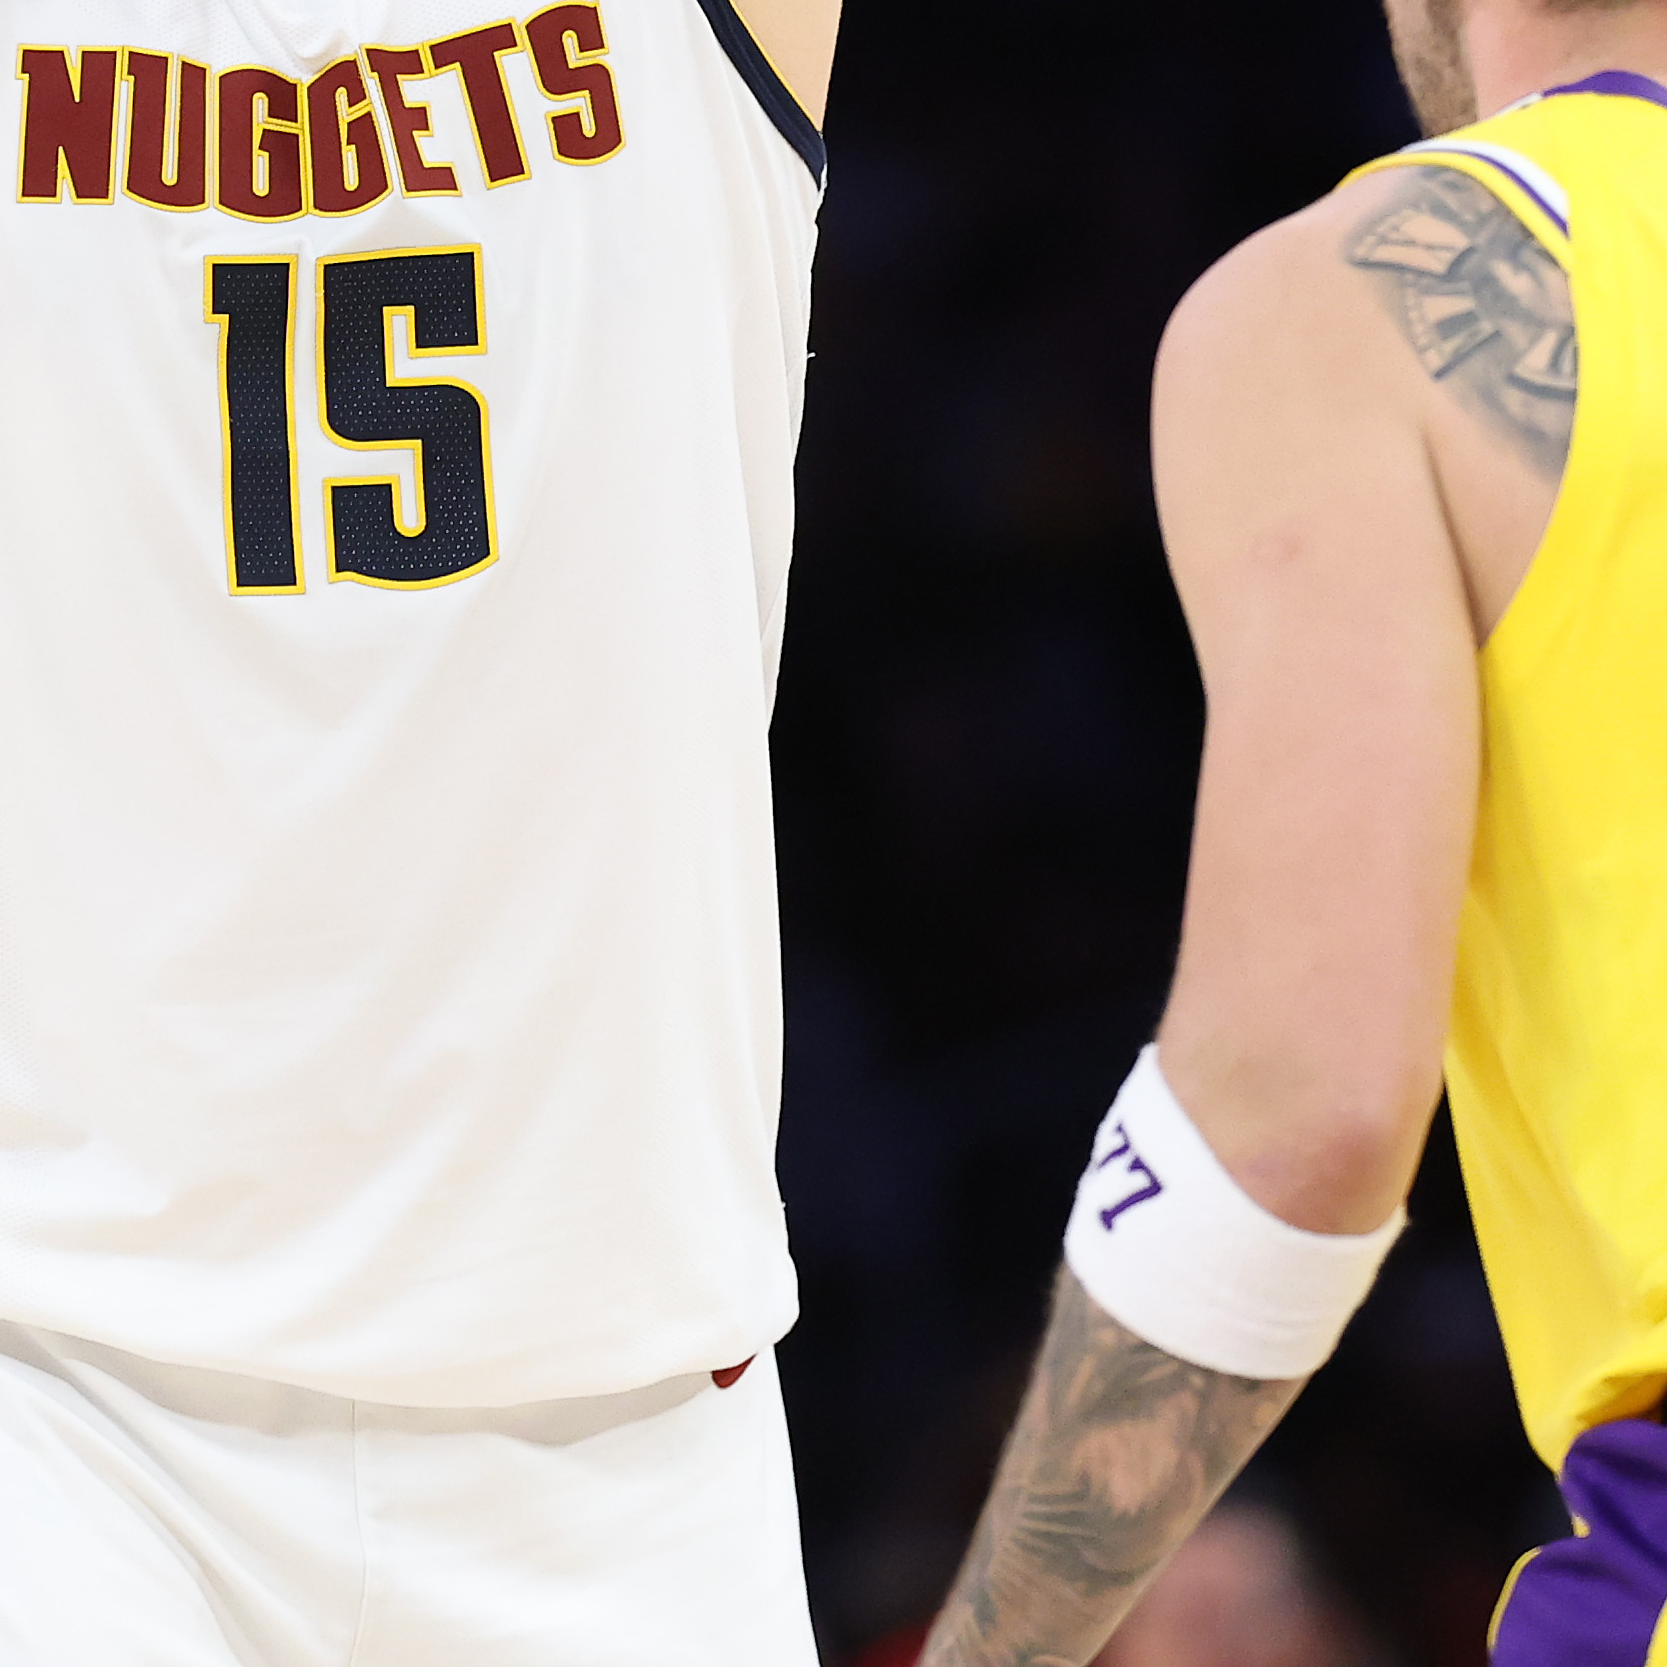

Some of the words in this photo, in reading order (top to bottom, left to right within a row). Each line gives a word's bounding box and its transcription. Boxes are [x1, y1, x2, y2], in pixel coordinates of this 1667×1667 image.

[15, 0, 626, 224] NUGGETS
[203, 243, 500, 596] 15
[1096, 1123, 1164, 1232] 77
